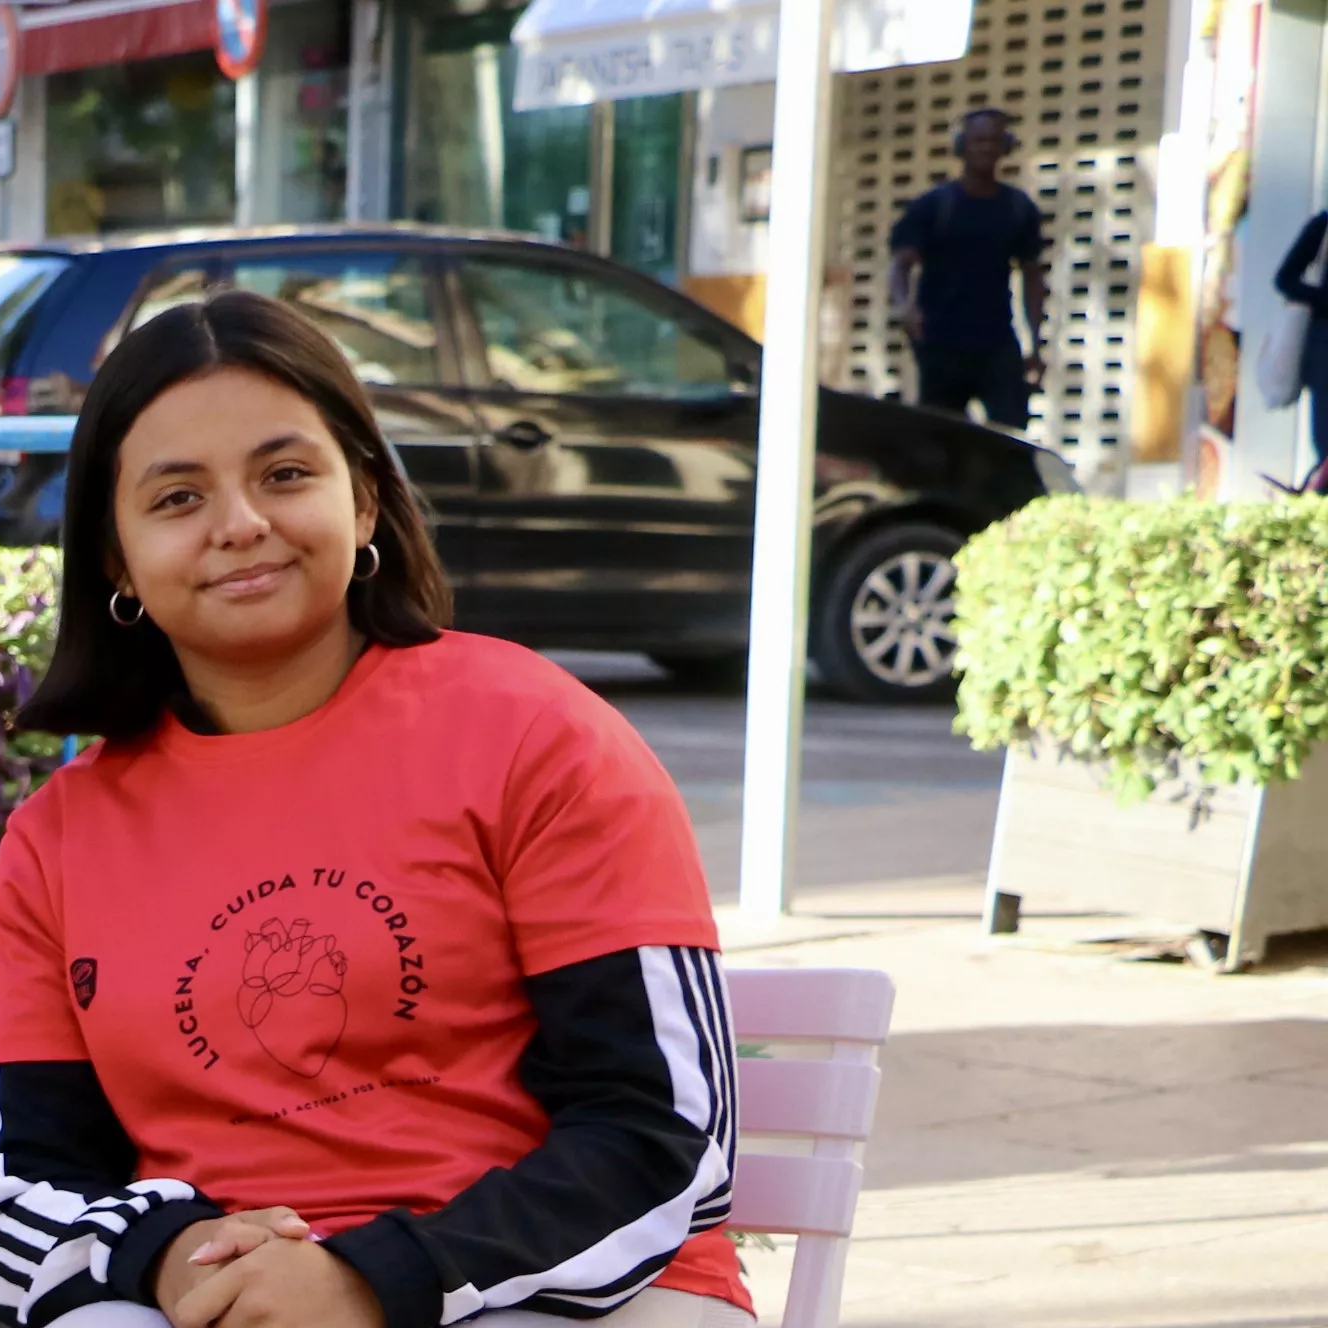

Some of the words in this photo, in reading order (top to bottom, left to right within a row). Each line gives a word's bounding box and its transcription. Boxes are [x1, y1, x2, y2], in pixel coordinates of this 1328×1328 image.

[210, 873, 296, 932] CUIDA
[313, 867, 346, 889] TU
[355, 879, 429, 1021] CORAZÓN
[295, 1091, 348, 1112] ACTIVAS
[352, 1083, 375, 1096] POR
